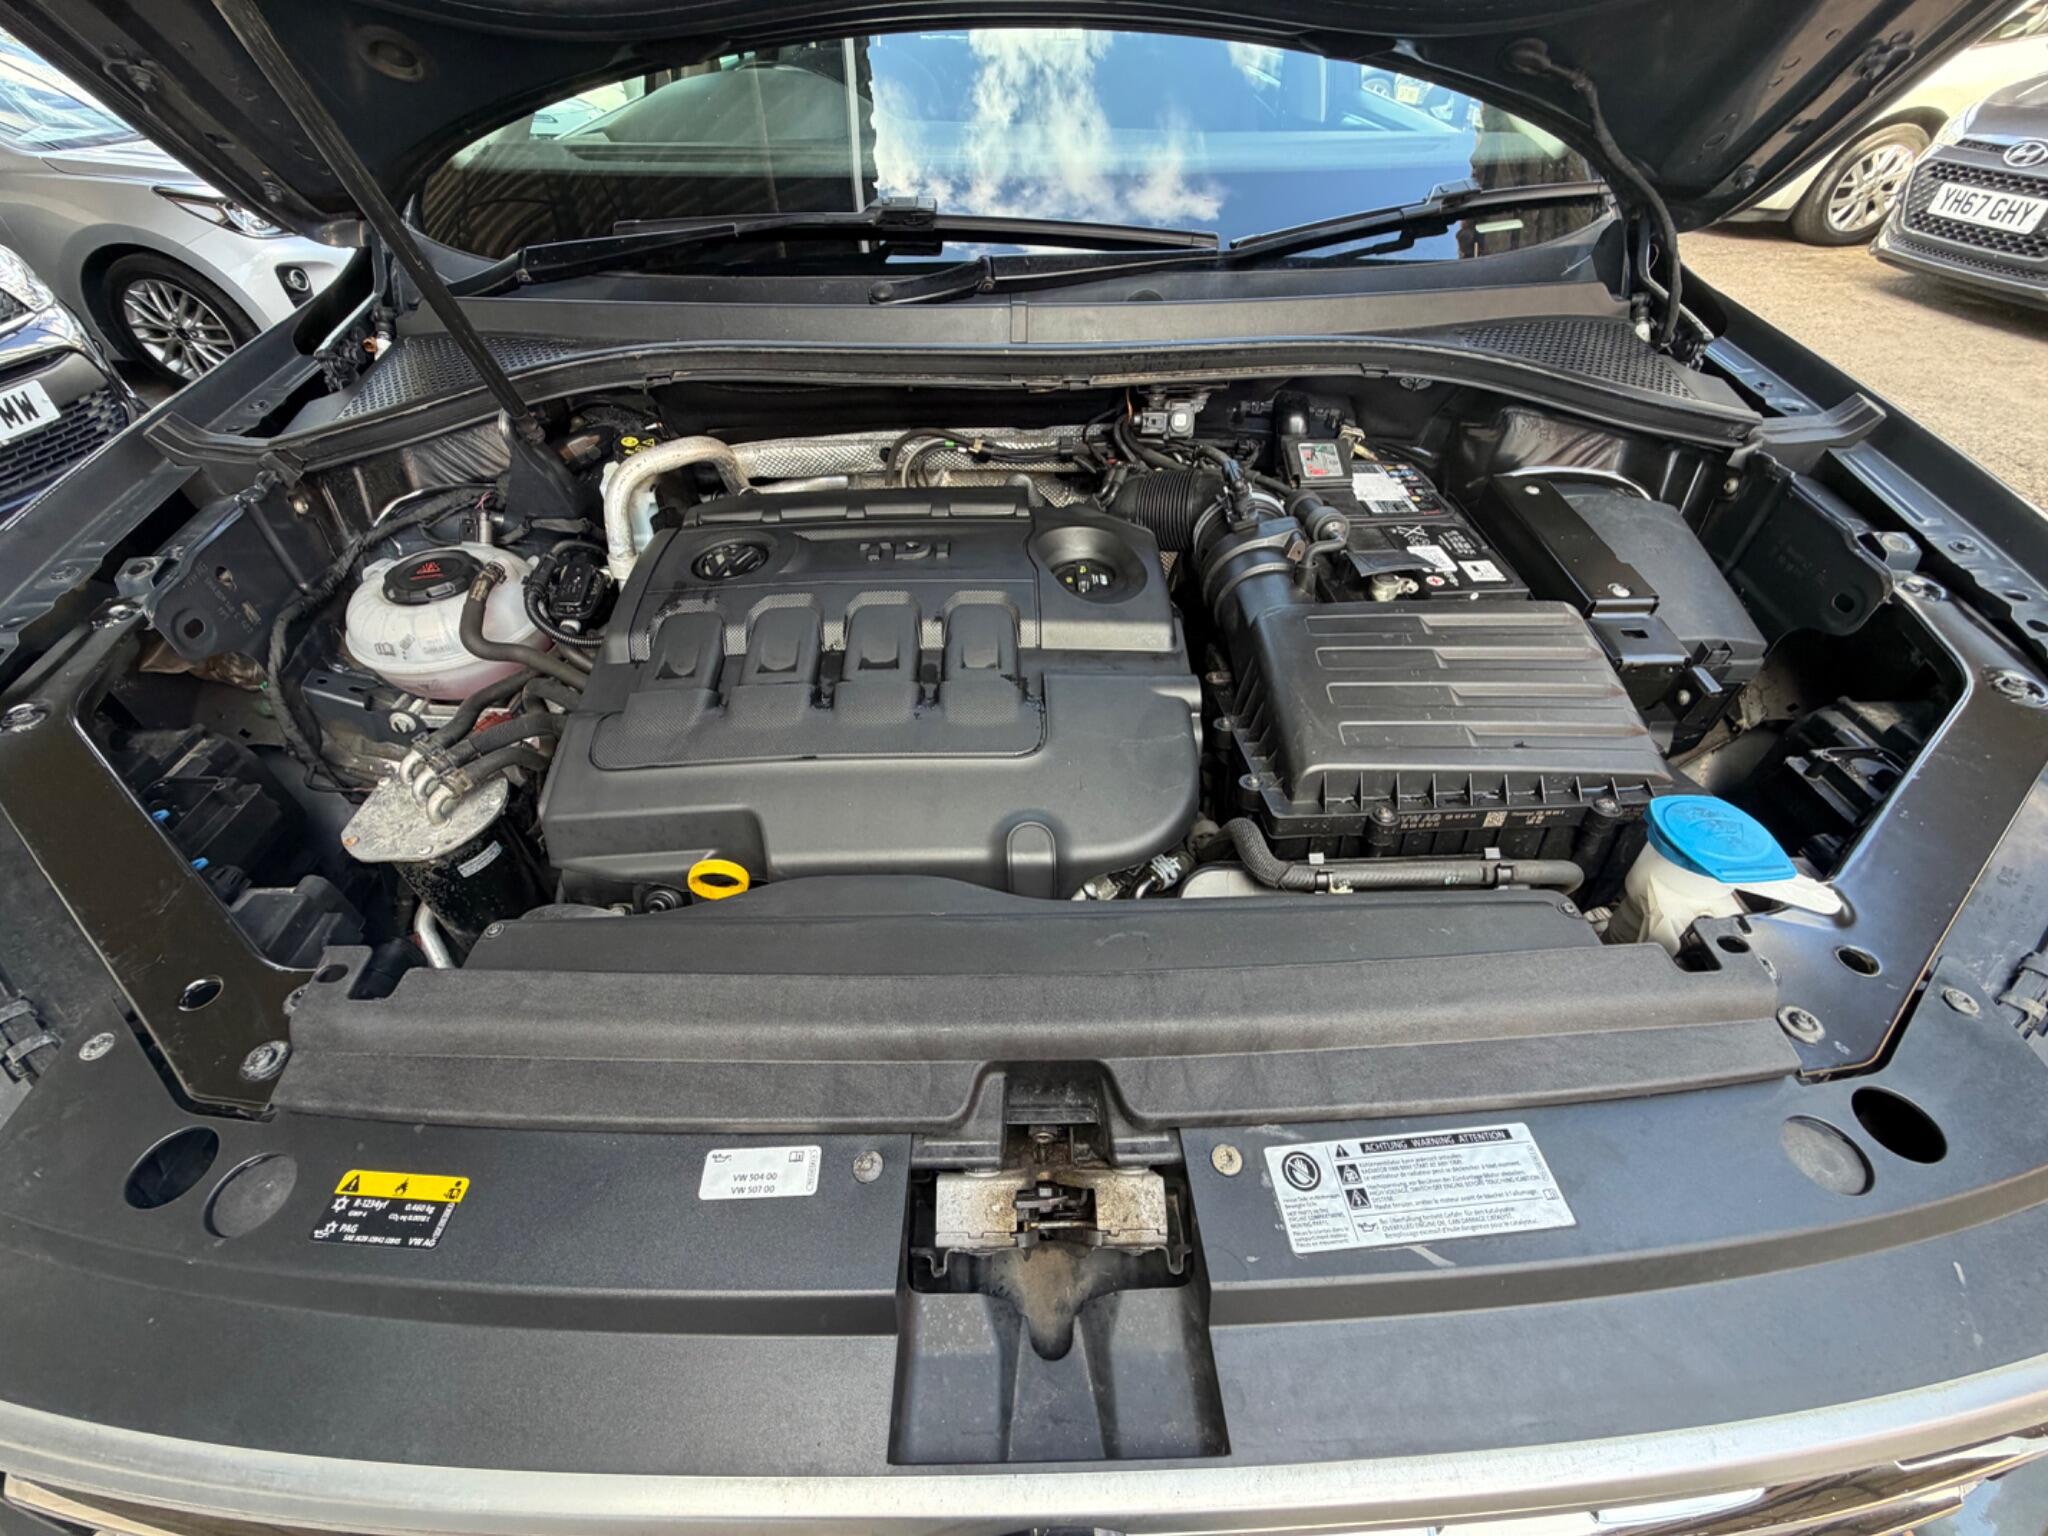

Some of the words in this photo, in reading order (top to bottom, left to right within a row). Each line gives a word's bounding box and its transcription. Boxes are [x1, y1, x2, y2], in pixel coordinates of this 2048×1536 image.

[1940, 188, 1992, 217] YH67
[1988, 199, 2039, 226] GHY
[859, 541, 951, 561] TDI
[1364, 1140, 1408, 1152] ACHTUNG
[1411, 1135, 1454, 1148] WARNING
[1458, 1130, 1506, 1144] ATTENTION
[733, 1173, 748, 1182] VW
[749, 1172, 764, 1182] 504
[766, 1171, 778, 1181] 00
[731, 1186, 746, 1194] VW
[748, 1185, 762, 1194] 507
[764, 1184, 775, 1193] 00
[339, 1223, 359, 1234] PAG
[408, 1237, 424, 1246] VW
[422, 1238, 437, 1247] AG
